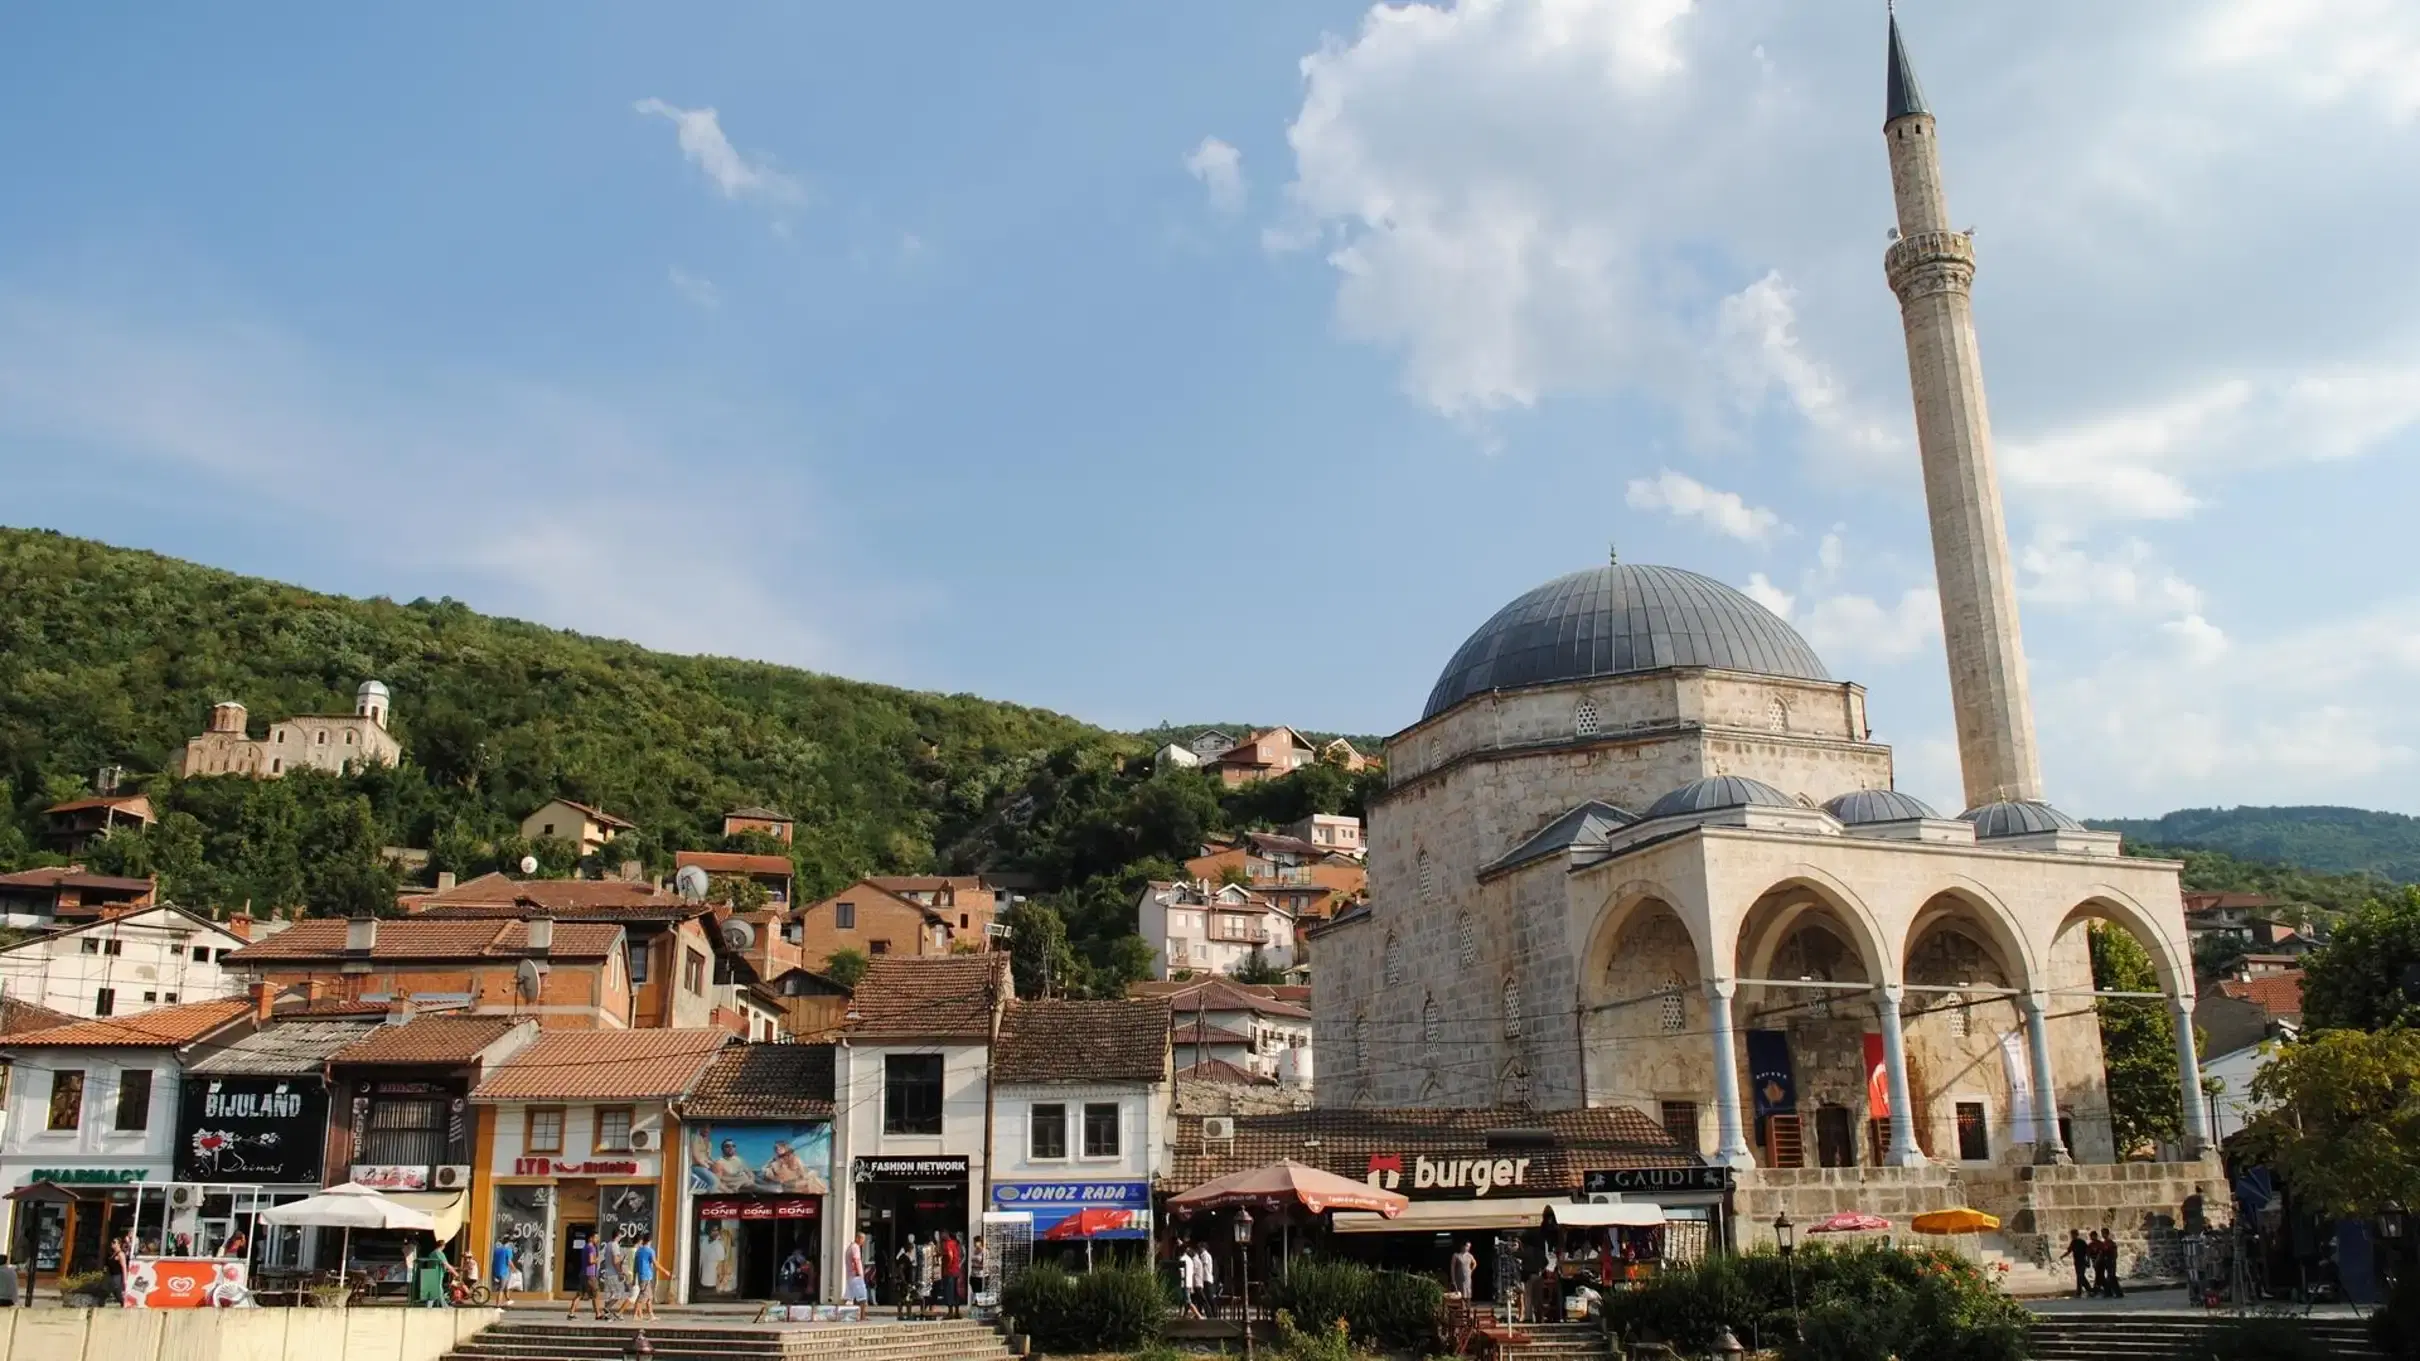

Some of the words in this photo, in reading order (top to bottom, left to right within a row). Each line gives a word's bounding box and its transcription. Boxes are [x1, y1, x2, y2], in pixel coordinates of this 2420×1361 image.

[205, 1093, 301, 1117] BIJULAND
[871, 1161, 915, 1172] FASHION
[917, 1161, 966, 1172] NETWORK
[1414, 1154, 1530, 1196] burger
[31, 1168, 149, 1184] PHARMACY
[1614, 1169, 1695, 1187] GAUDI
[1081, 1185, 1127, 1200] RADA
[602, 1212, 618, 1222] 10%
[513, 1221, 545, 1238] 50%
[619, 1222, 649, 1239] 50%
